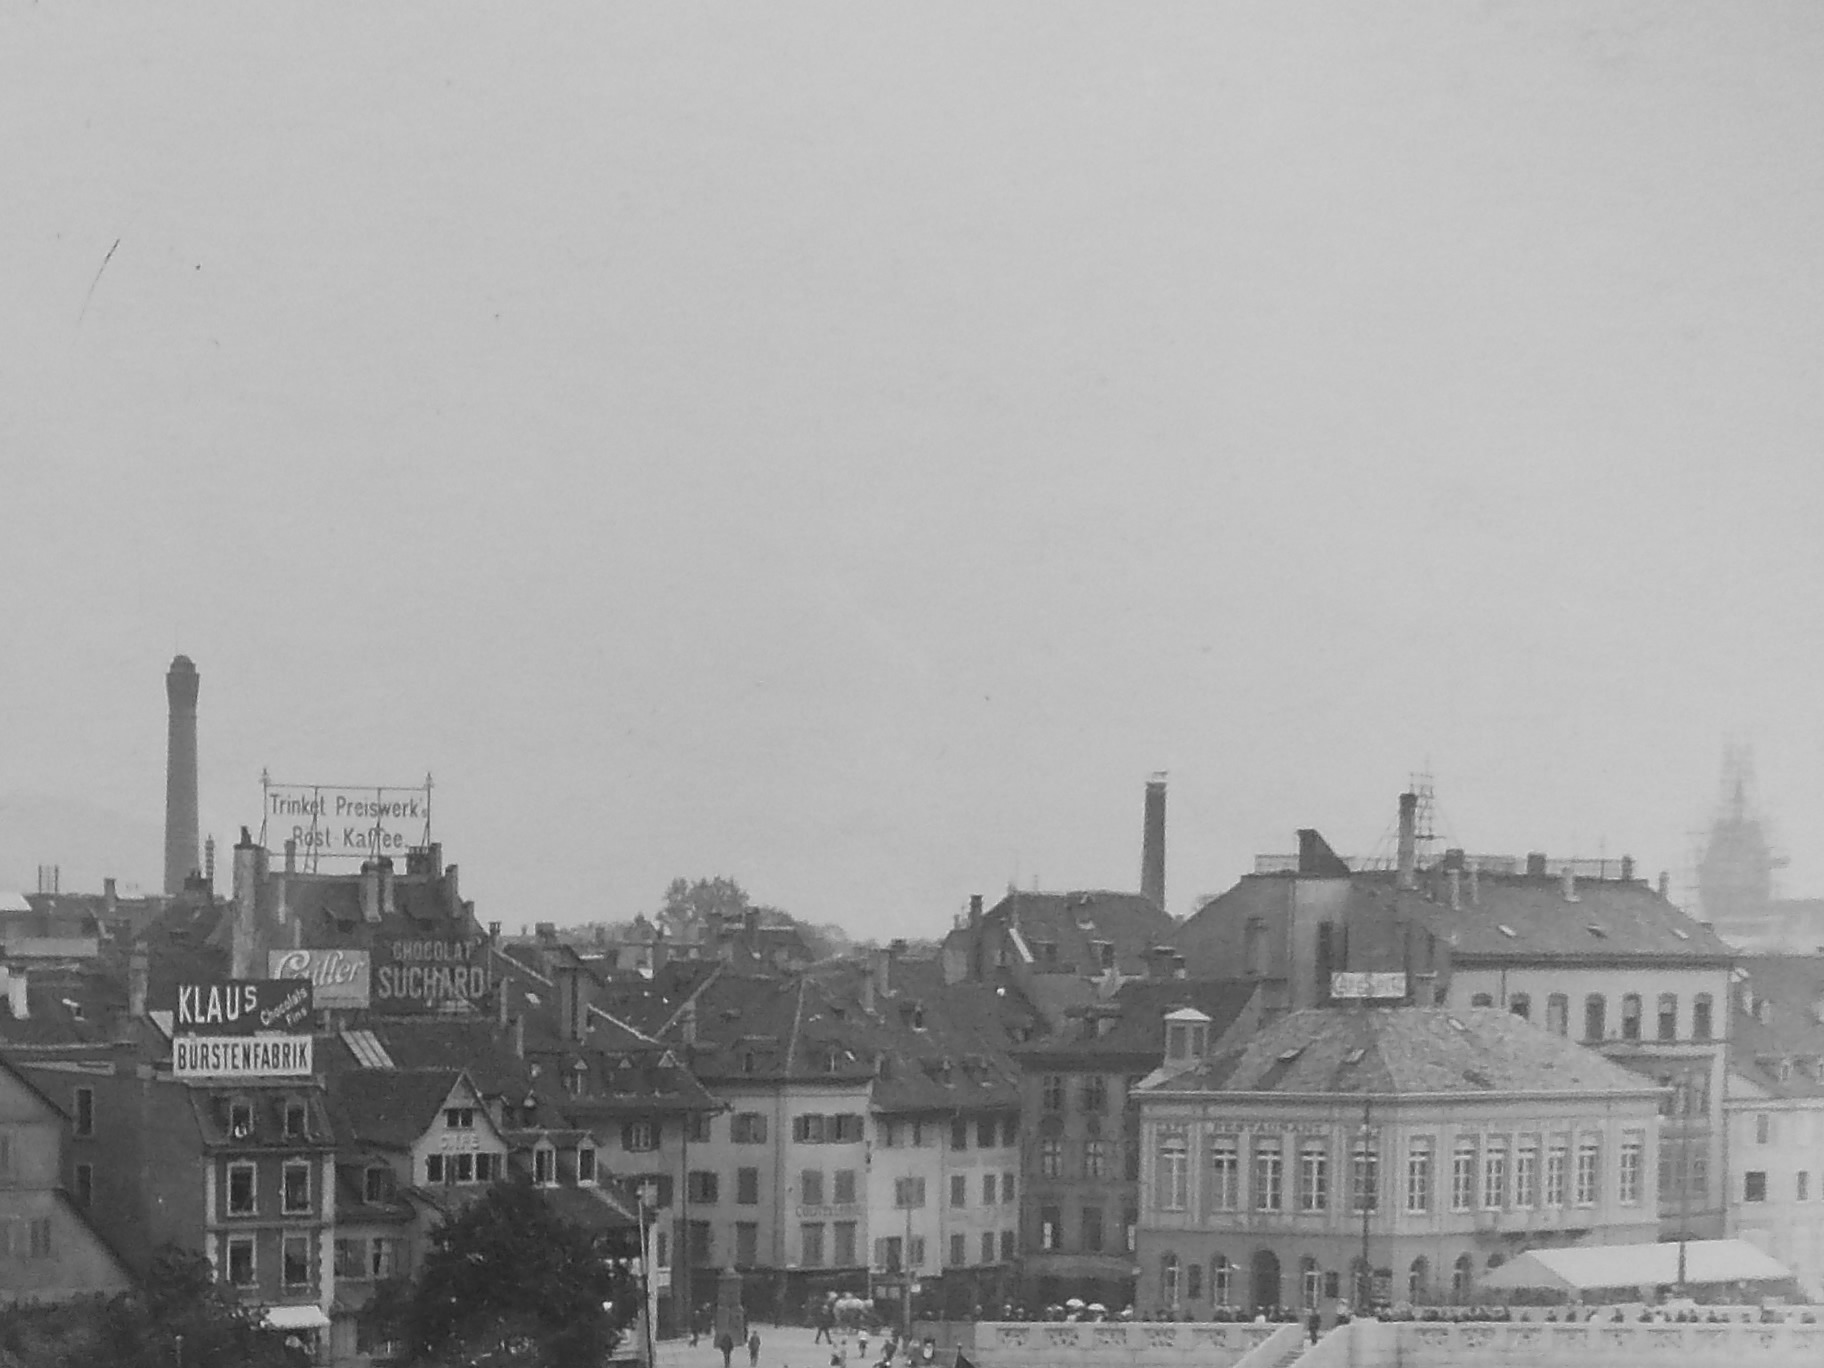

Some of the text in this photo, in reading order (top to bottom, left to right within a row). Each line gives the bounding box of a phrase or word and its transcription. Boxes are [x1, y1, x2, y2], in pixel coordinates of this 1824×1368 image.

[269, 793, 326, 816] Trinket
[392, 940, 475, 961] CHOCOLAT
[274, 950, 365, 987] Ciller
[377, 966, 484, 999] SUCHARD
[178, 985, 258, 1024] KLAUS
